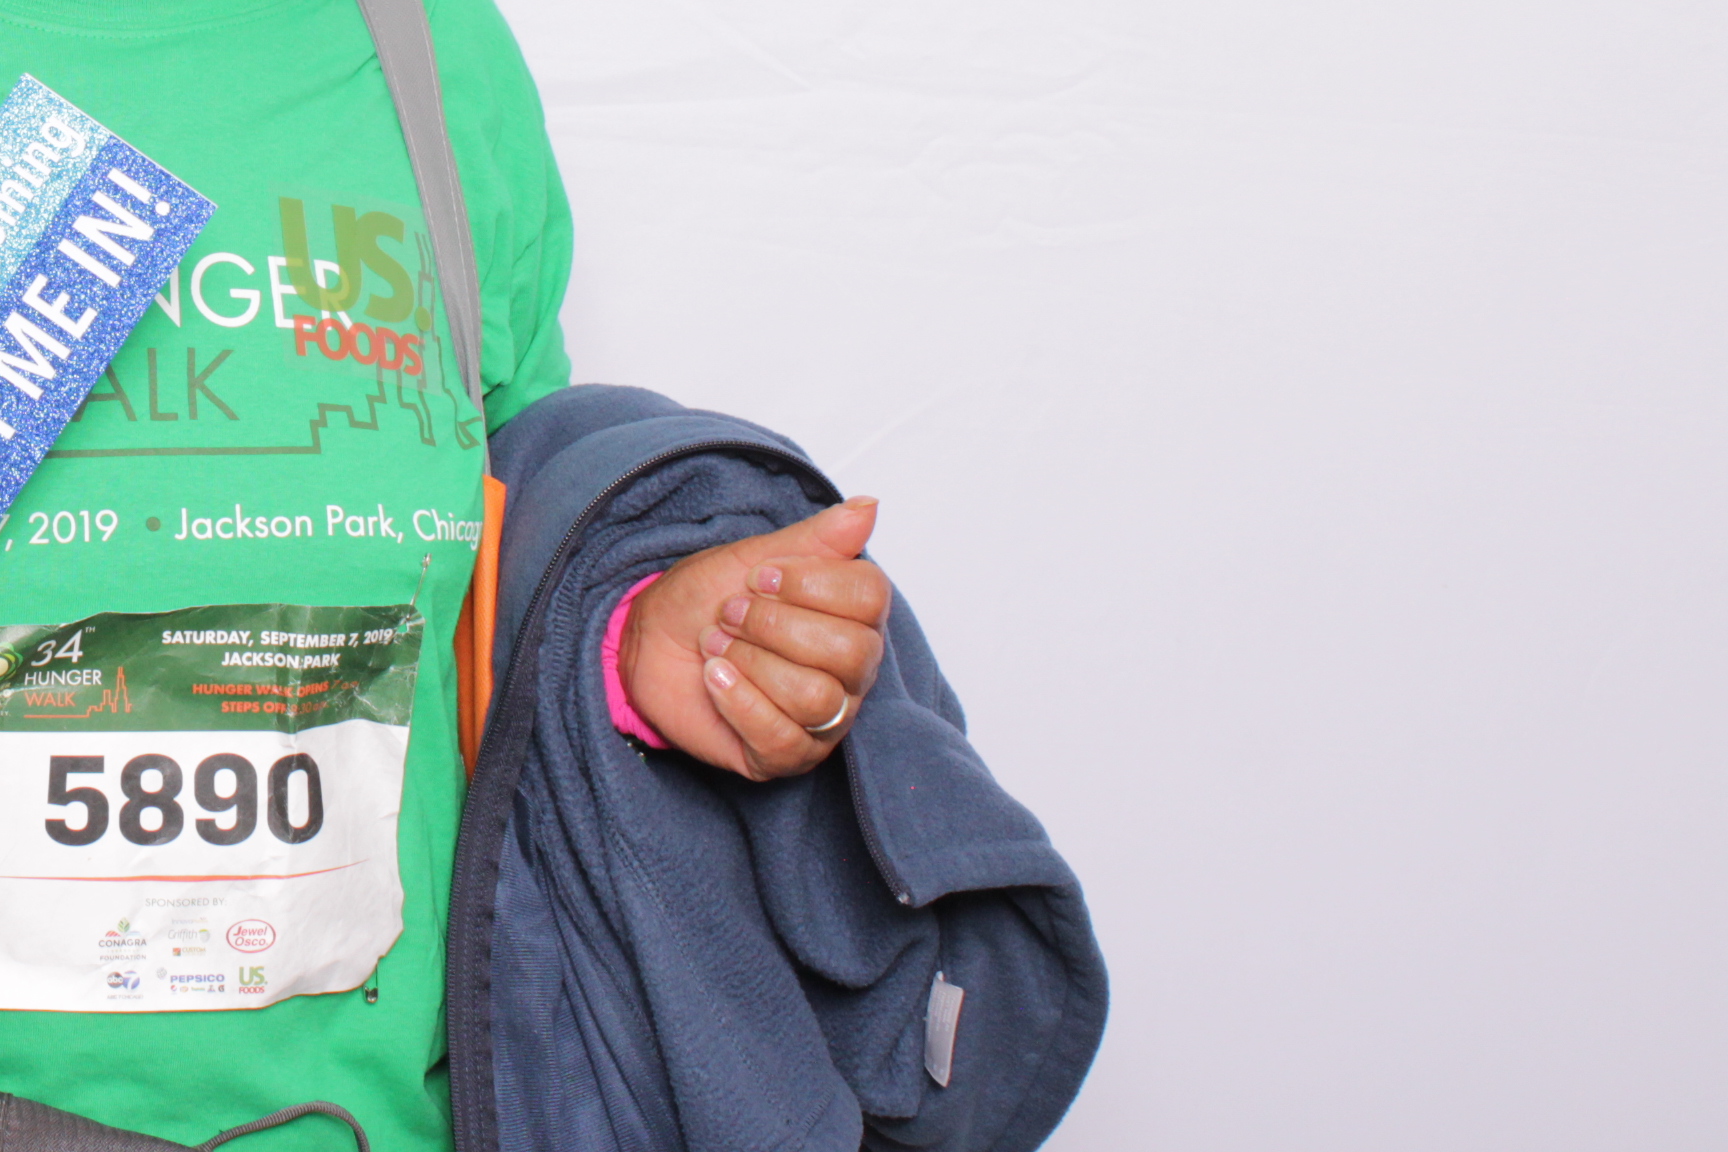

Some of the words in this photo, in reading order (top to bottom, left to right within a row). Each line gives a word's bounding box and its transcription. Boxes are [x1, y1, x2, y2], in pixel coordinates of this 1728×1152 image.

[59, 167, 172, 288] IN!
[292, 314, 425, 376] FOODS
[71, 347, 240, 422] ALK
[28, 509, 119, 544] 2019
[174, 504, 313, 542] Jackson
[325, 505, 404, 544] Park,
[412, 508, 483, 551] Chicag
[162, 630, 254, 647] SATURDAY,
[260, 631, 345, 648] SEPTEMBER
[348, 632, 359, 648] 7,
[362, 628, 393, 645] 2019
[221, 651, 300, 669] JACKSON
[303, 653, 341, 669] PARK
[24, 669, 102, 686] HUNGER
[192, 684, 252, 695] HUNGER
[255, 684, 295, 699] WALK
[296, 680, 330, 698] OPENS
[24, 692, 76, 707] WALK
[221, 701, 260, 713] STEPS
[263, 701, 287, 714] OFF
[44, 752, 325, 847] 5890
[145, 898, 210, 908] SPONSORED
[233, 926, 268, 937] Jewel
[98, 938, 148, 948] CONAGRA
[170, 974, 225, 983] PEPSICO
[239, 986, 265, 994] FOODS
